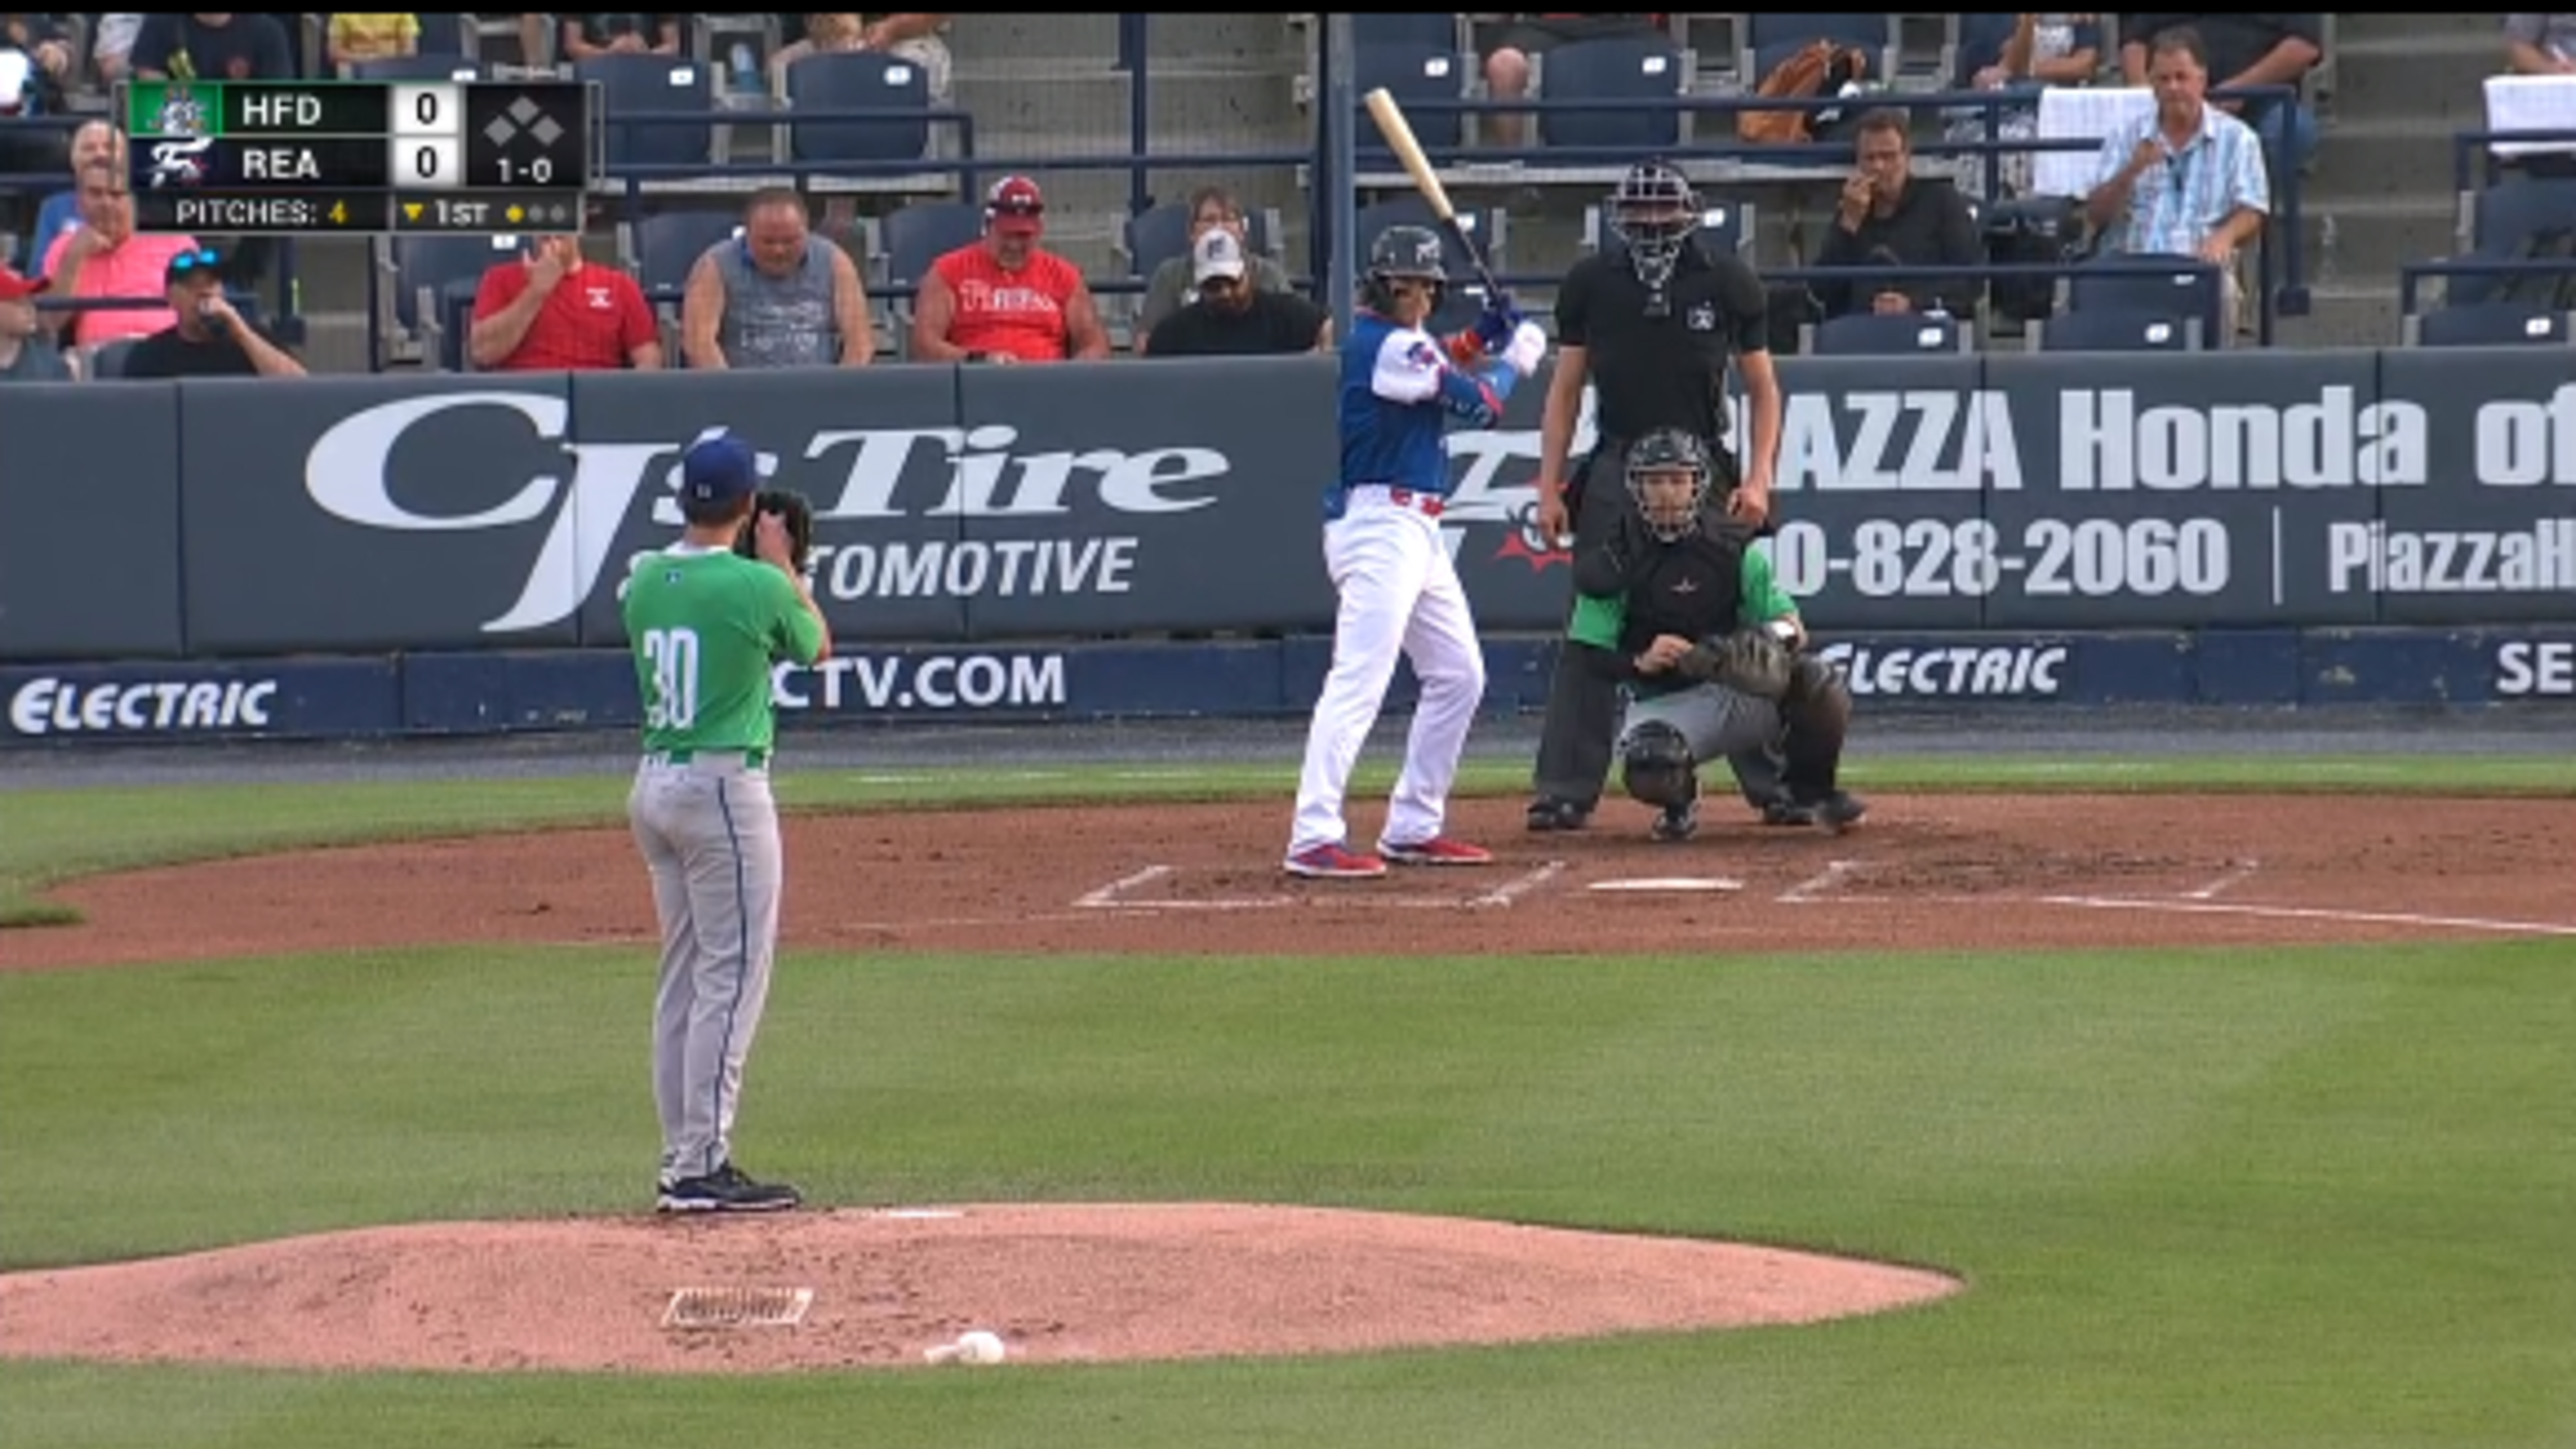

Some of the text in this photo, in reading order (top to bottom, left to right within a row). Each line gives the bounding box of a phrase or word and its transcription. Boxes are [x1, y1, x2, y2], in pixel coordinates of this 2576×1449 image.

[802, 423, 1230, 517] Tire
[2059, 385, 2428, 490] Honda
[1757, 517, 2576, 596] 0-828-2060 PiazzaH
[9, 677, 278, 734] ELECTRIC
[643, 628, 699, 730] 30
[2496, 641, 2574, 694] SE
